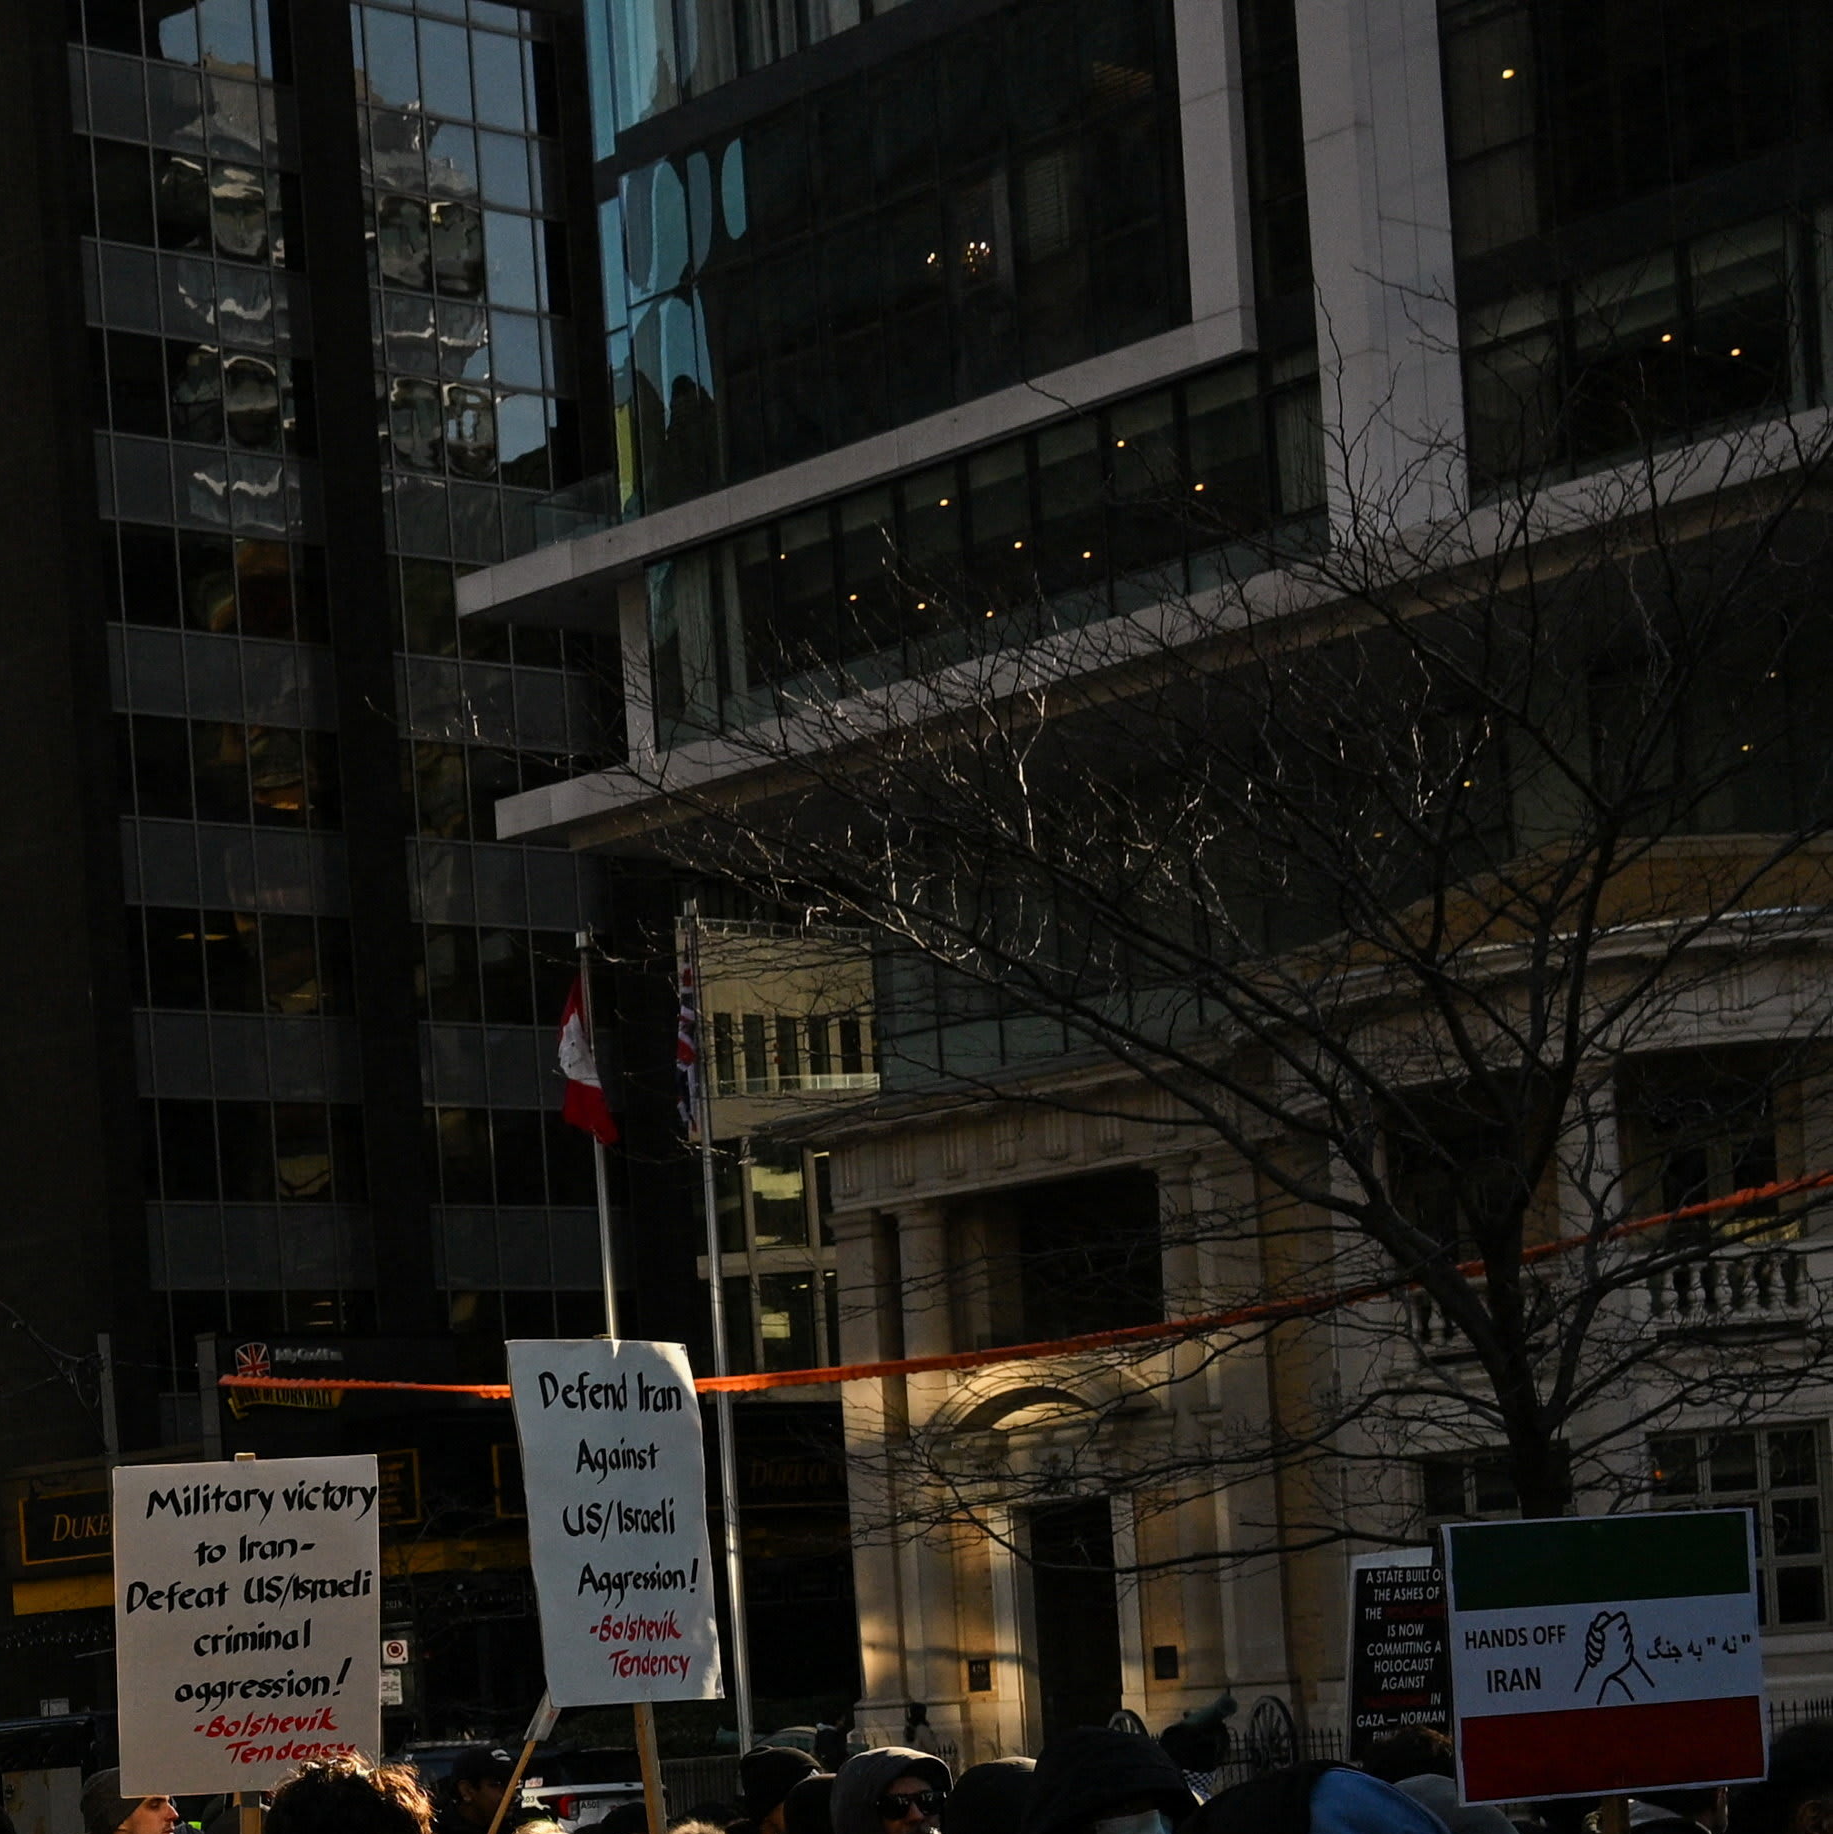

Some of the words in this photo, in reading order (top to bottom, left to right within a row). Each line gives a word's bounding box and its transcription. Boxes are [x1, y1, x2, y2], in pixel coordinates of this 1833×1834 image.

[538, 1371, 628, 1412] Defend
[637, 1372, 683, 1412] Iran
[575, 1438, 660, 1485] Against
[146, 1480, 274, 1524] Military
[282, 1480, 379, 1522] victory
[562, 1500, 676, 1541] US/Israeli
[194, 1537, 229, 1566] to
[577, 1558, 699, 1609] Aggression!
[1366, 1571, 1374, 1584] A
[1376, 1570, 1403, 1584] STATE
[1406, 1568, 1430, 1583] BUILT
[1432, 1569, 1443, 1582] O
[126, 1581, 229, 1615] Defeat
[242, 1570, 372, 1608] US/Israeli
[1374, 1588, 1391, 1602] THE
[1393, 1587, 1424, 1601] ASHES
[1426, 1586, 1440, 1600] OF
[1365, 1607, 1382, 1621] THE
[192, 1619, 312, 1655] criminal
[1387, 1624, 1396, 1637] IS
[1398, 1623, 1424, 1637] NOW
[1464, 1627, 1528, 1651] HANDS
[1532, 1624, 1566, 1646] OFF
[1366, 1641, 1431, 1657] COMMITTING
[1434, 1640, 1442, 1653] A
[609, 1649, 691, 1682] Tendency
[1374, 1658, 1434, 1673] HOLOCAUST
[173, 1657, 351, 1713] aggression!
[1381, 1675, 1425, 1690] AGAINST
[1485, 1667, 1542, 1693] IRAN
[1430, 1692, 1441, 1705] IN
[1356, 1712, 1385, 1728] GAZA
[1400, 1710, 1446, 1725] NORMAN
